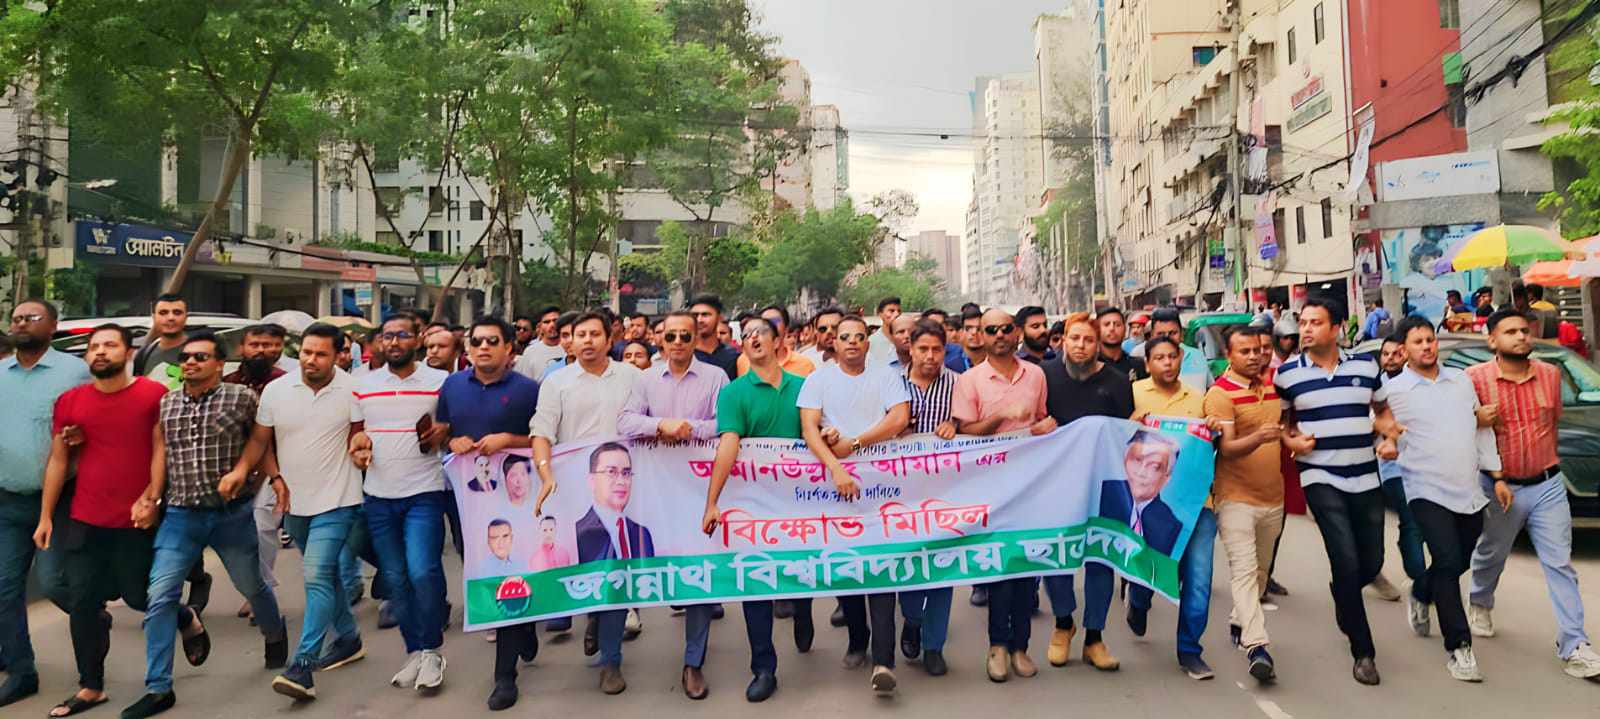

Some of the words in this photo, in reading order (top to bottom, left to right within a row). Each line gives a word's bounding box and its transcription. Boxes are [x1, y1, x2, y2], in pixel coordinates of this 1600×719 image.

[871, 451, 961, 477] আমান
[719, 507, 864, 548] বিক্ষোভ
[880, 499, 992, 537] মিছিল
[557, 560, 717, 601] জগন্নাথ
[728, 542, 1005, 593] বিশ্ববিদ্যালয়
